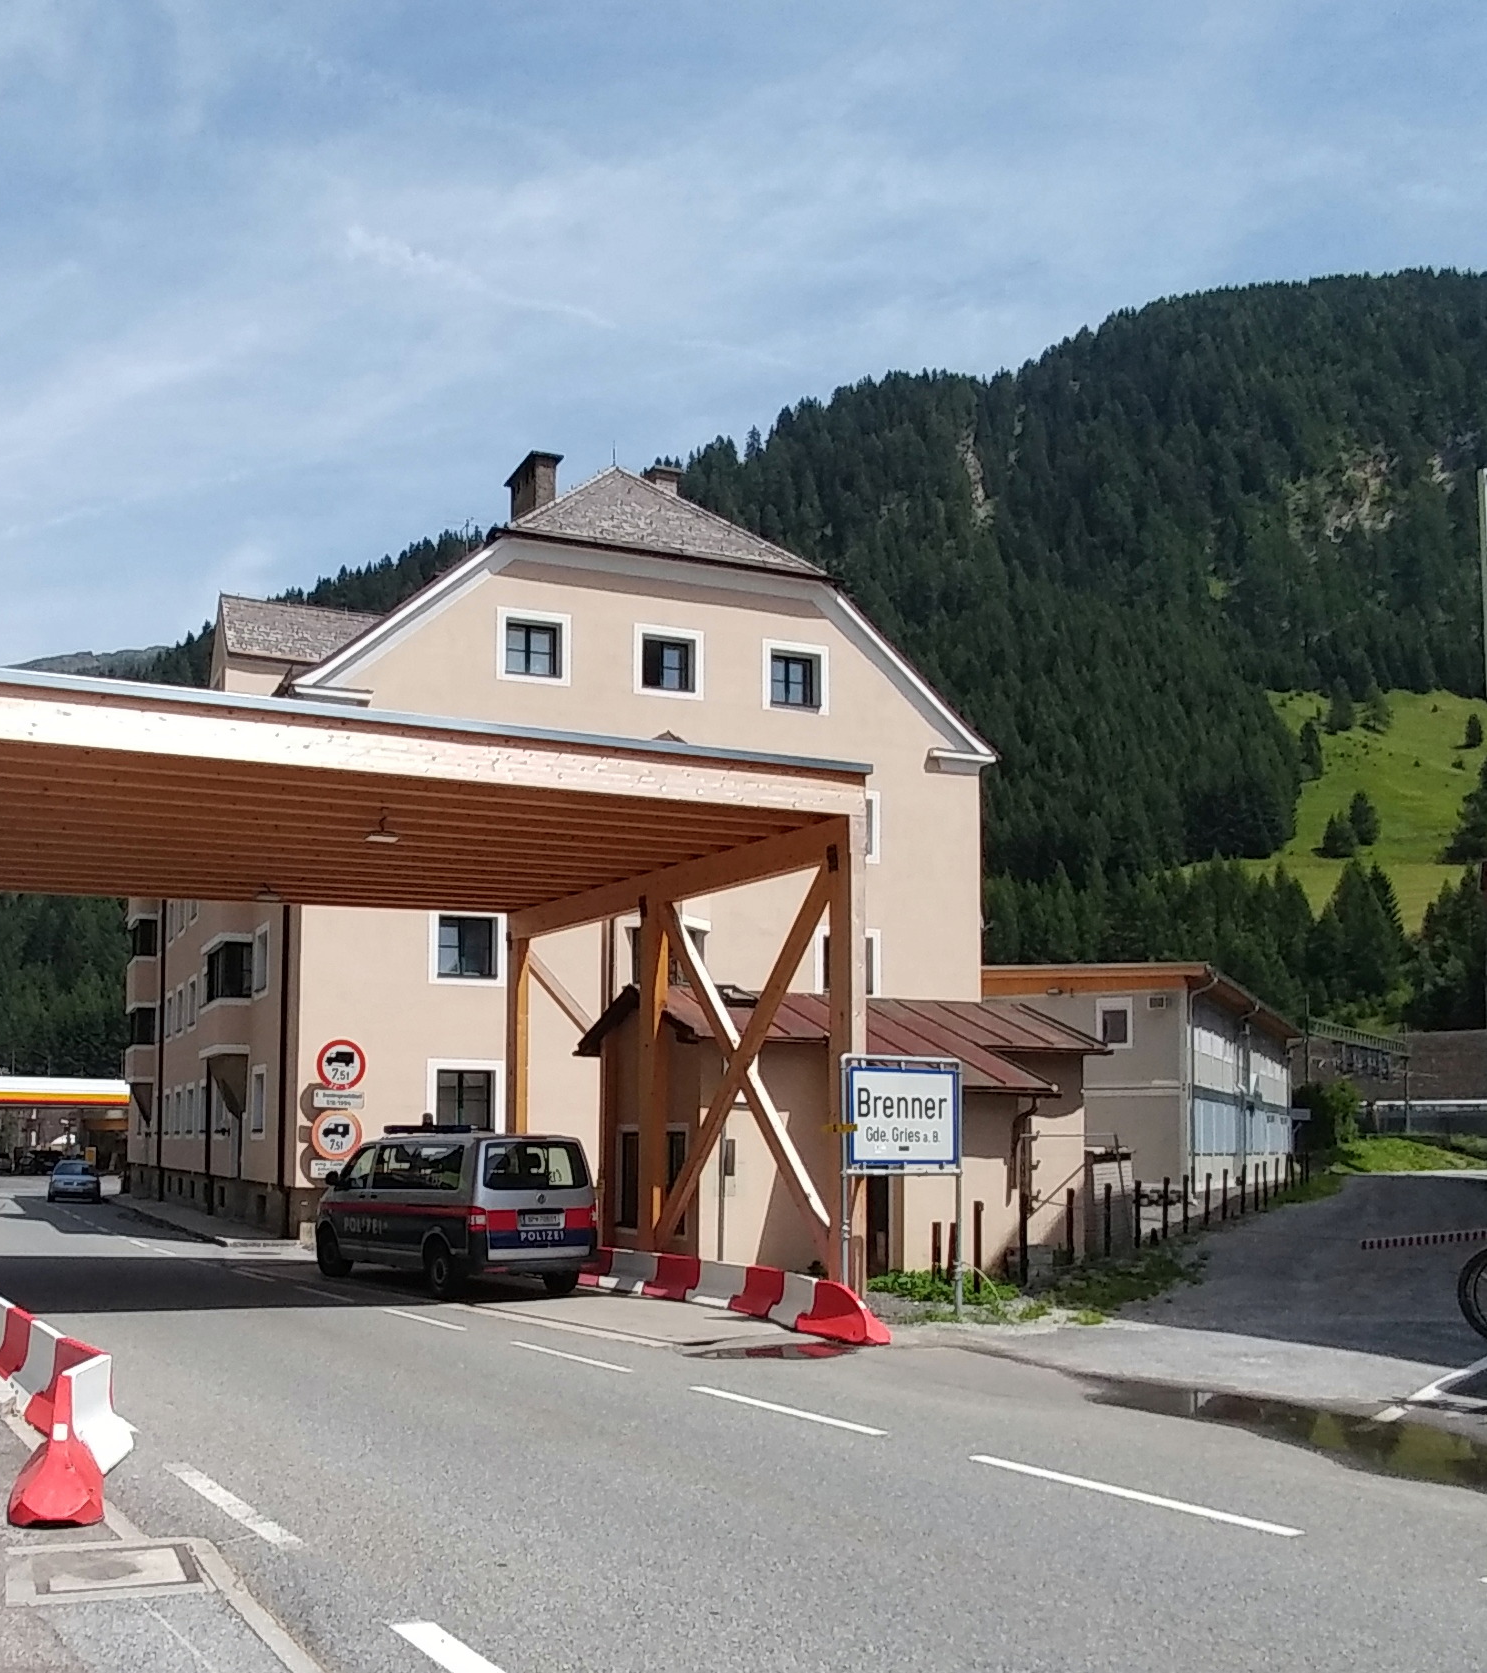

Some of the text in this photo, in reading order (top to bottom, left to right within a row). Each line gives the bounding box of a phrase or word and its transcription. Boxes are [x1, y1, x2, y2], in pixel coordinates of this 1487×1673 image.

[857, 1087, 948, 1119] Brenner
[865, 1126, 890, 1143] Gde.
[891, 1126, 921, 1143] Gries
[519, 1230, 565, 1242] POLIZEI
